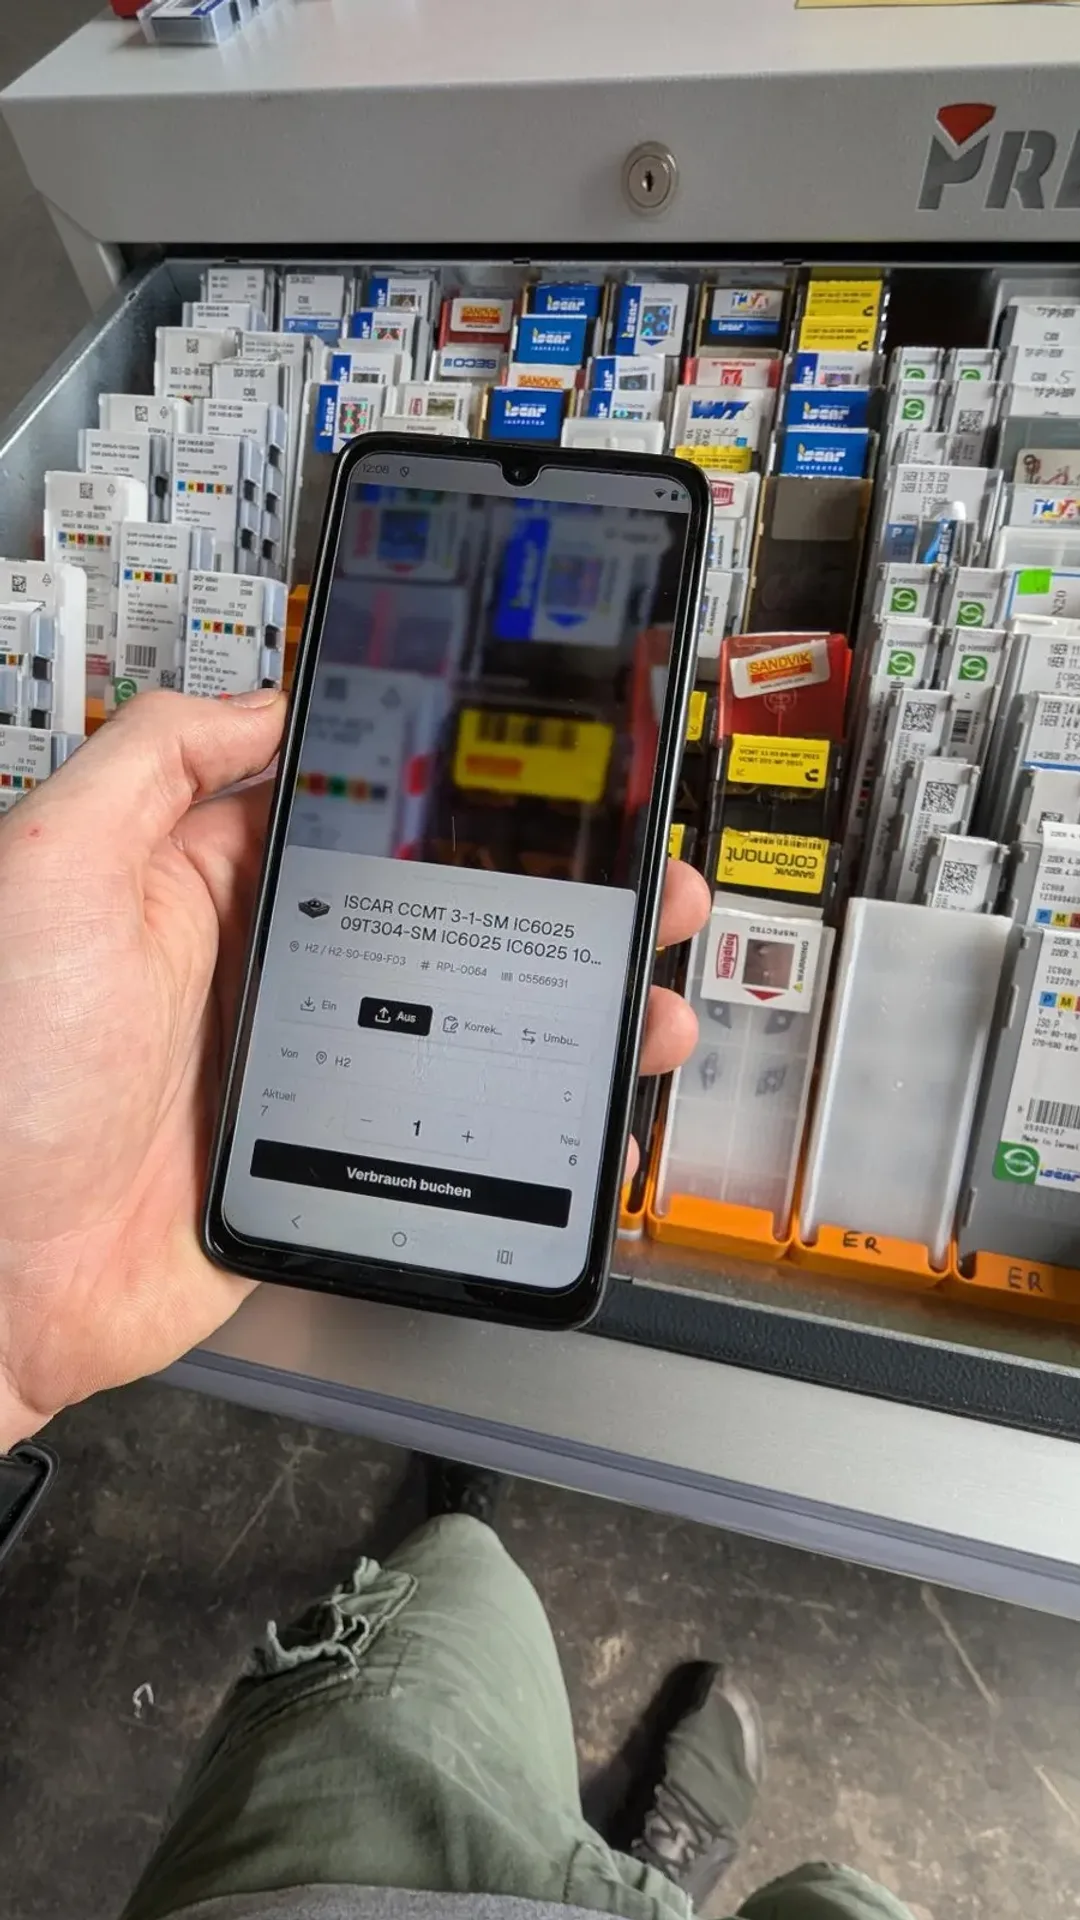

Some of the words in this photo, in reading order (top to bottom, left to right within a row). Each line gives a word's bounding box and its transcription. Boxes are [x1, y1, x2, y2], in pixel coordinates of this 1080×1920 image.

[749, 652, 811, 673] SANDVIK
[725, 846, 818, 869] coromant
[774, 866, 815, 879] SANDVIK
[344, 895, 393, 914] ISCAR
[398, 902, 447, 921] CCMT
[451, 909, 509, 930] 3-1-SM
[513, 917, 575, 939] IC6025
[340, 916, 437, 942] 09T304-SM
[441, 930, 501, 951] IC6025
[506, 939, 567, 960] IC6025
[749, 925, 798, 938] INSPECTED
[305, 943, 319, 953] H2
[518, 973, 569, 989] 05566931
[321, 1000, 337, 1011] Ein
[396, 1010, 417, 1024] Aus
[280, 1047, 299, 1059] Von
[335, 1055, 352, 1068] H2
[260, 1104, 269, 1117] 7
[412, 1120, 422, 1137] 1
[559, 1134, 581, 1147] Neu
[568, 1154, 578, 1167] 6
[346, 1166, 417, 1190] Verbrauch
[419, 1176, 472, 1199] buchen
[843, 1230, 881, 1254] ER
[1007, 1266, 1044, 1293] ER
